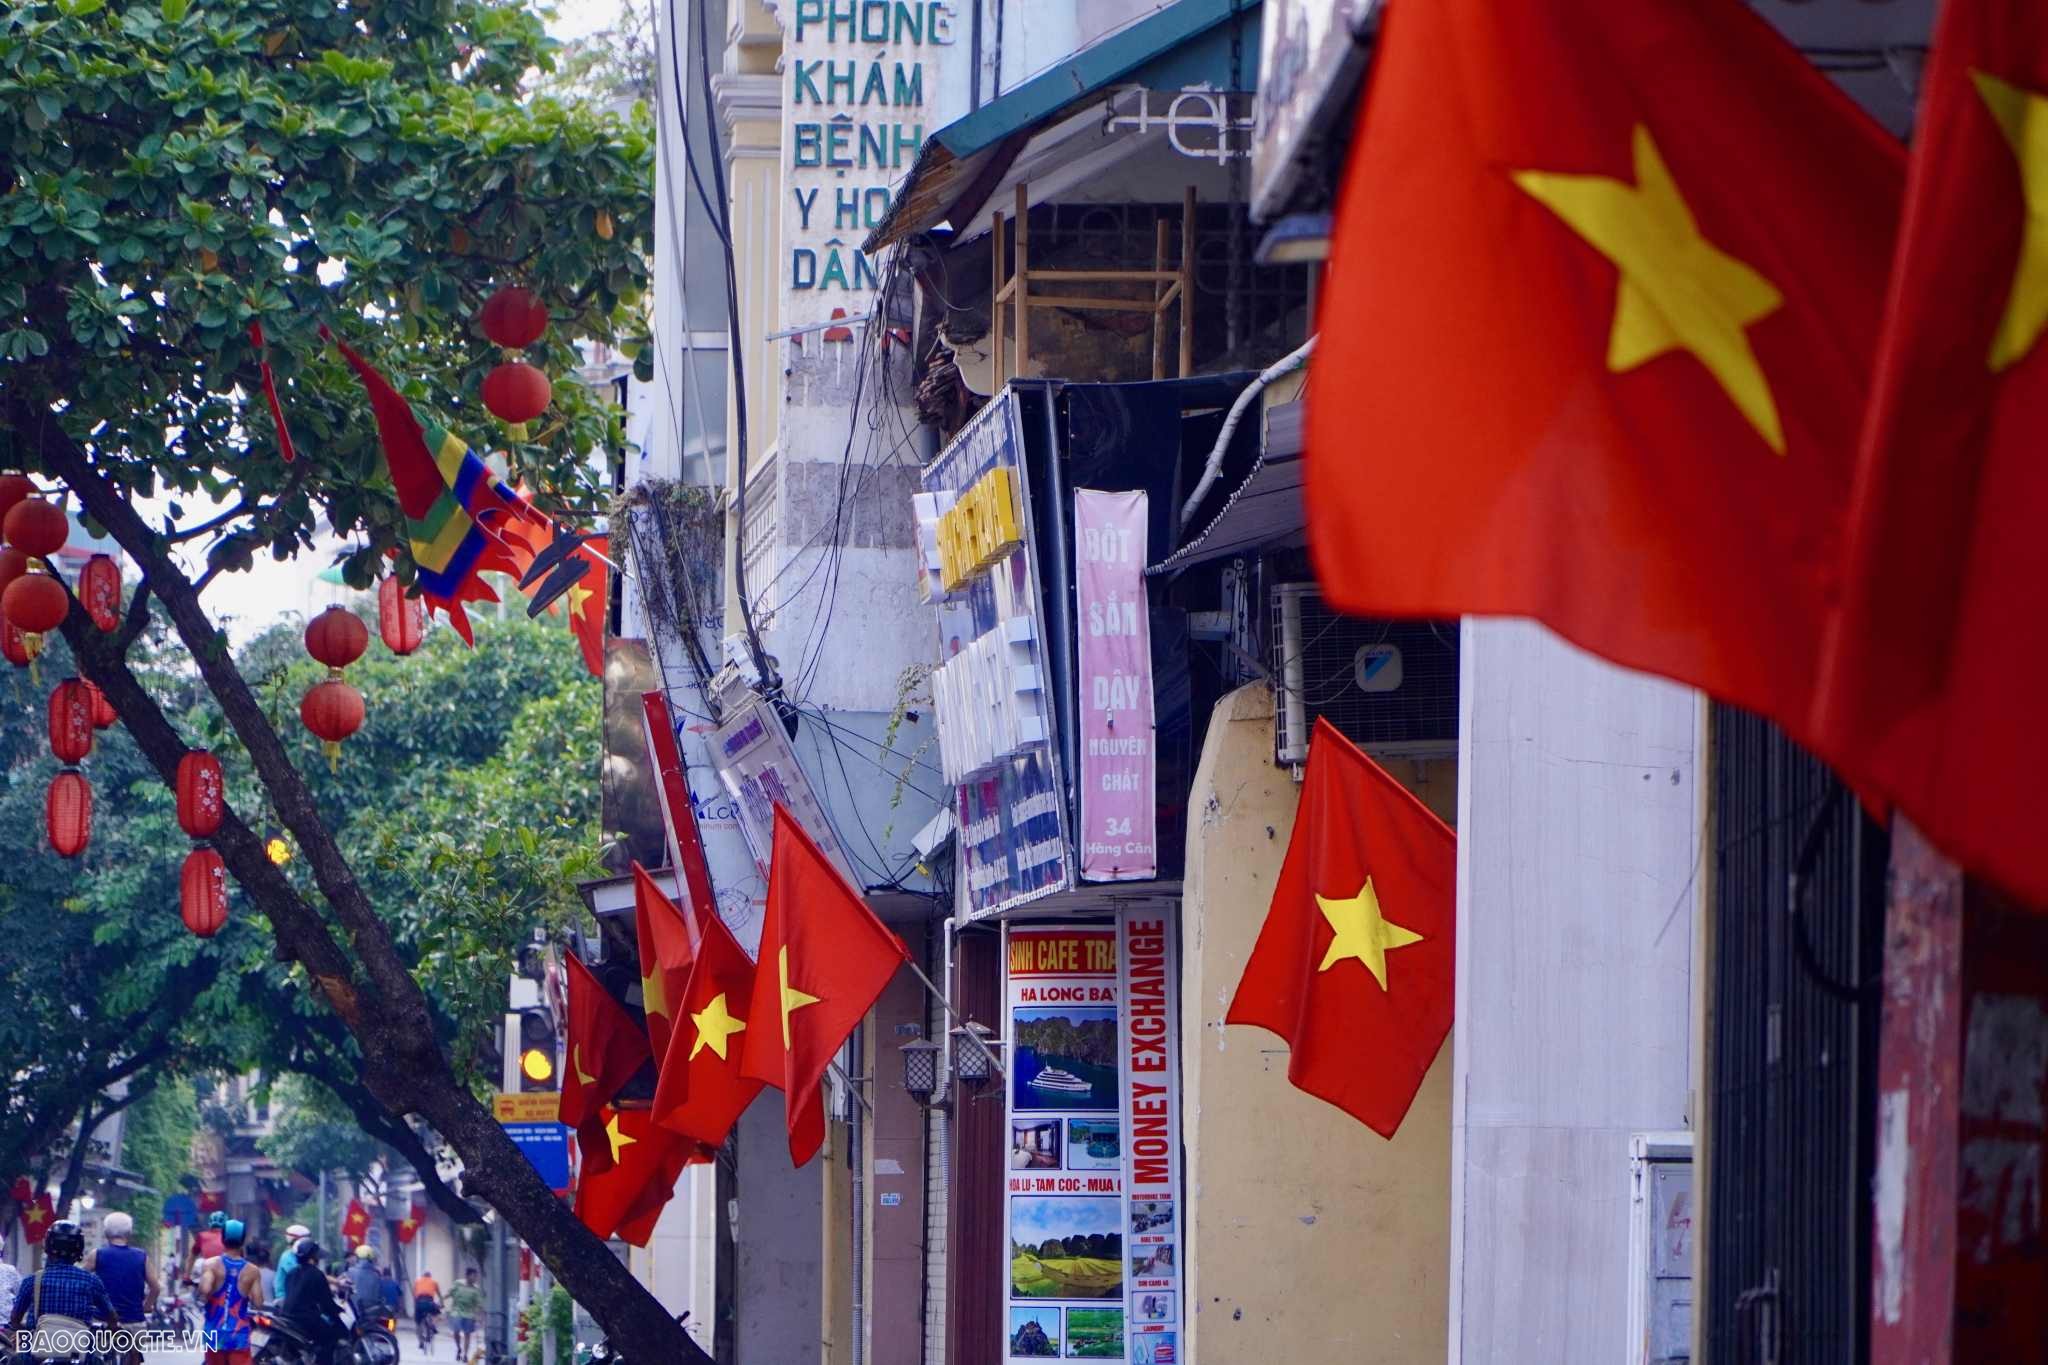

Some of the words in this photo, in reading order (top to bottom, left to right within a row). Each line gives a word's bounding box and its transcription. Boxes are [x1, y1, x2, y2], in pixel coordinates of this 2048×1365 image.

[794, 50, 923, 107] KHÁM
[794, 112, 923, 177] BỆNH
[794, 187, 819, 230] Y
[791, 237, 879, 291] DÂN
[1084, 522, 1132, 571] BỘT
[1089, 590, 1137, 637] SẮN
[1105, 817, 1132, 837] 34
[1010, 941, 1033, 972] SINH
[1038, 940, 1079, 971] CAFE
[1022, 988, 1037, 1002] HA
[1041, 987, 1085, 1002] LONG
[1128, 919, 1167, 1073] EXCHANGE
[1132, 1082, 1169, 1184] MONEY
[1058, 1178, 1080, 1192] COC
[1088, 1178, 1114, 1192] MUA
